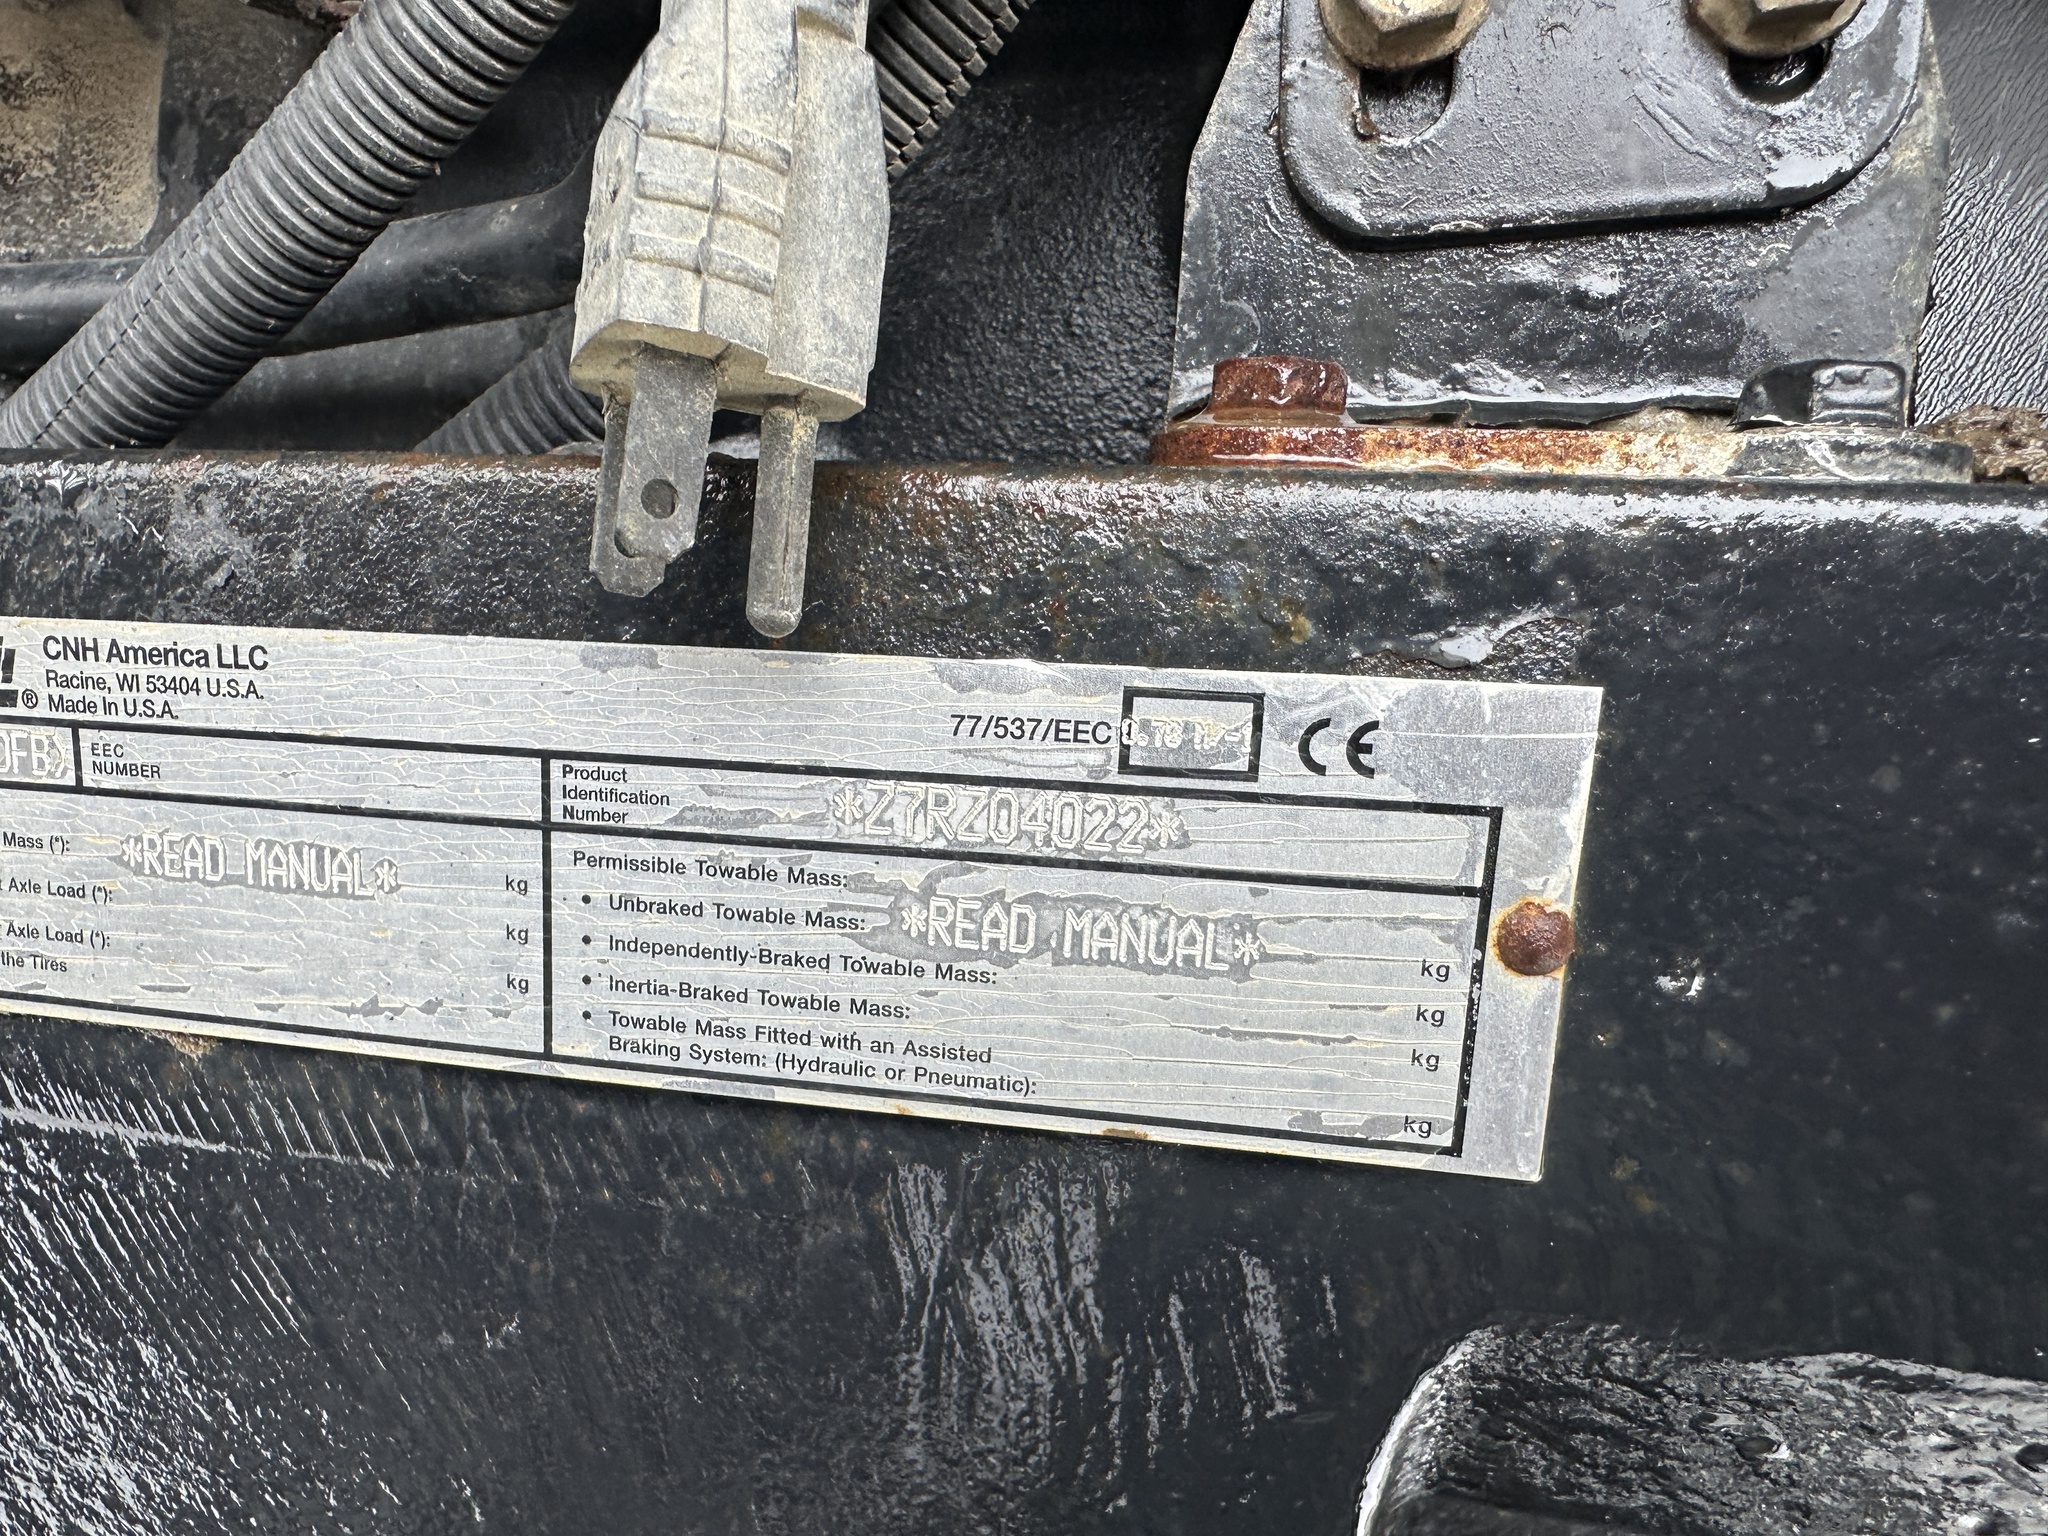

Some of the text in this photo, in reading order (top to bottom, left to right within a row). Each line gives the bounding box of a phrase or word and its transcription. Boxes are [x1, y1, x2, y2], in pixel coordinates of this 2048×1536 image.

[43, 635, 268, 671] CNH America LLC
[45, 669, 264, 701] Racine, WI 53404 U.S.A.
[48, 694, 179, 720] Made In U.S.A.
[950, 714, 1113, 745] 77/537/EEC
[91, 742, 124, 758] EEC
[92, 760, 161, 779] NUMBER
[562, 764, 628, 784] Product
[562, 784, 671, 808] Identification
[562, 805, 629, 825] Number
[3, 832, 44, 849] Mass
[505, 875, 529, 896] kg
[573, 850, 849, 889] Permissible Towable Mass:
[8, 877, 41, 894] Axle
[48, 880, 85, 899] Load
[506, 924, 529, 945] kg
[609, 894, 703, 919] Unbraked
[714, 902, 796, 927] Towable
[804, 909, 866, 931] Mass:
[1421, 959, 1451, 983] kg
[1, 952, 68, 972] the Tires
[6, 922, 40, 939] Axle
[46, 926, 84, 944] Load
[506, 973, 529, 994] kg
[609, 934, 1446, 1028] Independently-Braked Towable Mass: kg
[609, 975, 1440, 1071] Inertia-Braked Towable Mass: kg
[609, 1011, 992, 1065] Towable Mass Fitted with an Assisted
[609, 1036, 1433, 1139] Braking System: (Hydraulic or Pneumatic): kg
